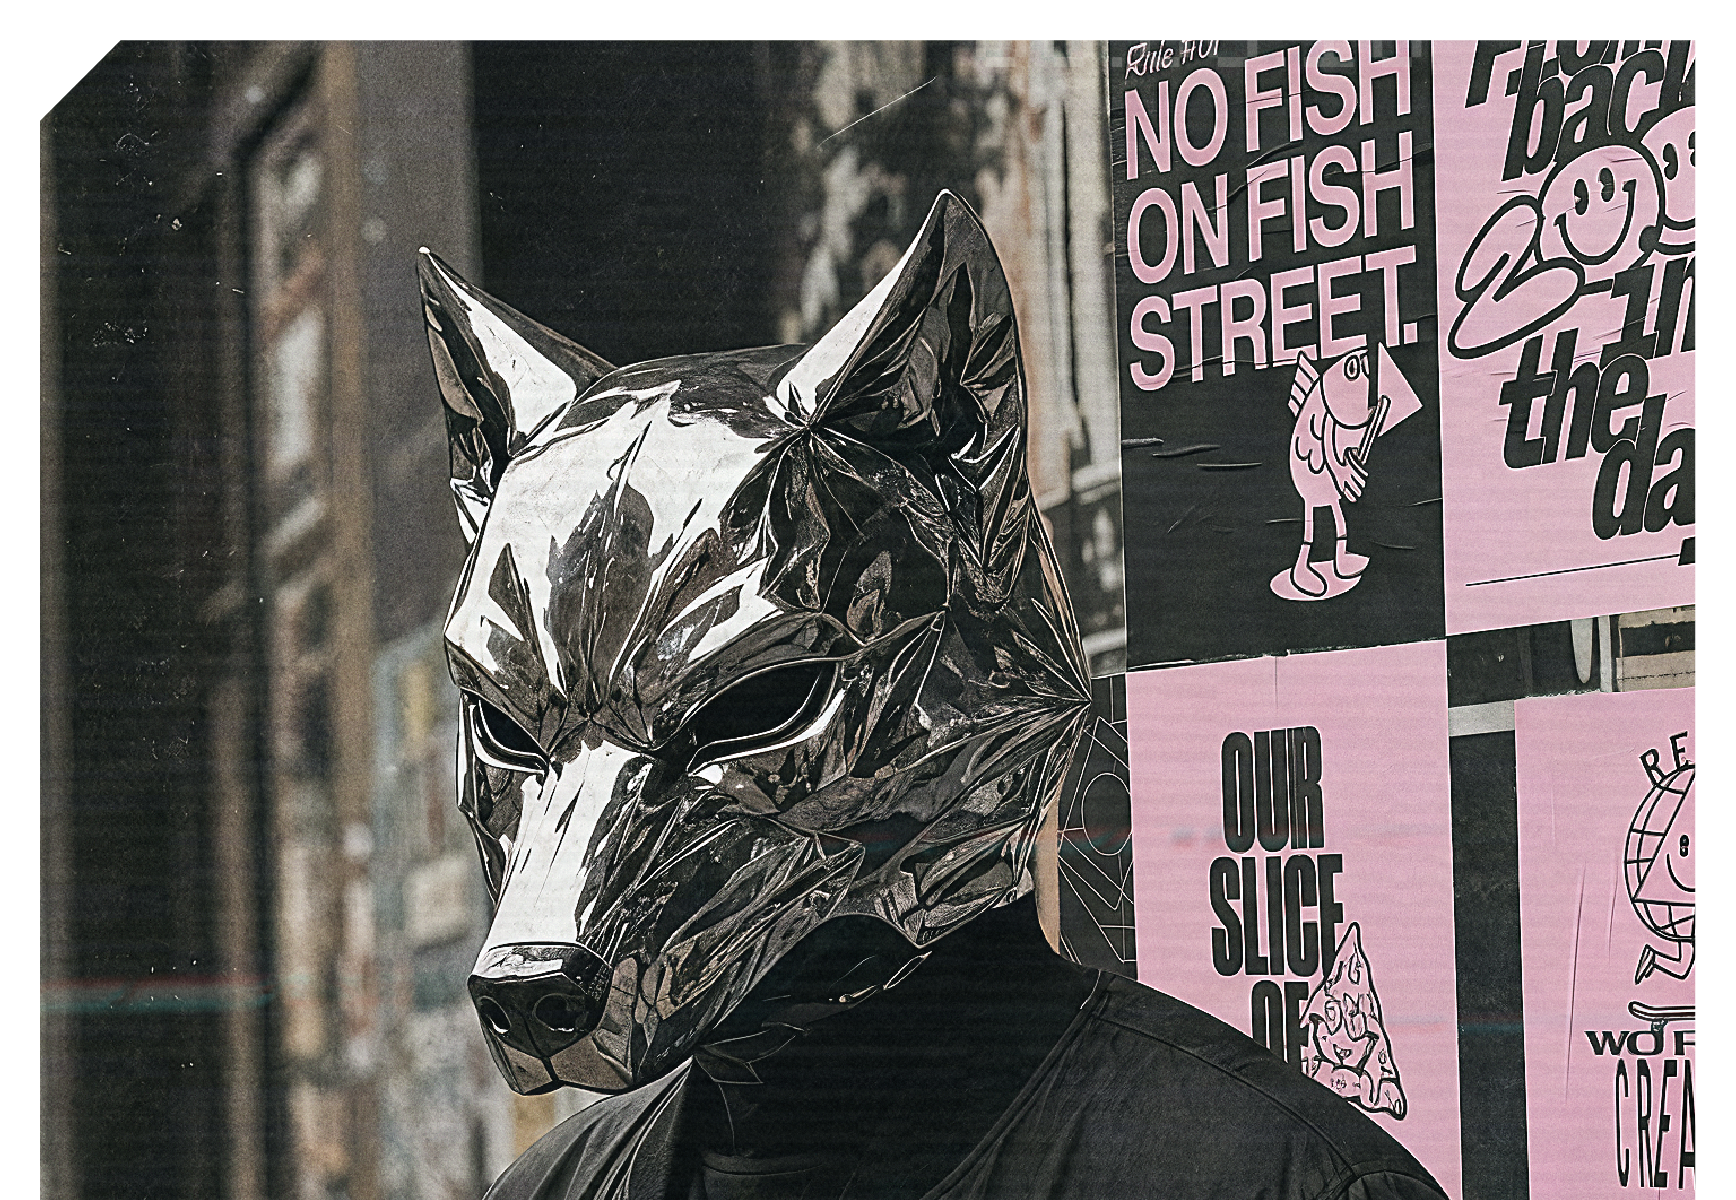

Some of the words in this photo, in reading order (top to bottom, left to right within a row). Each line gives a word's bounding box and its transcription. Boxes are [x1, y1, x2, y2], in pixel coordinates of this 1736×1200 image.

[1124, 67, 1229, 180] NO
[1245, 40, 1412, 153] FISH
[1125, 40, 1174, 82] Rule
[1126, 171, 1230, 285] ON
[1246, 132, 1415, 264] FISH
[1129, 245, 1419, 391] STREET.
[1499, 327, 1649, 467] the
[1592, 393, 1695, 566] da
[1220, 725, 1325, 853] OUR
[1209, 853, 1344, 978] SLICE
